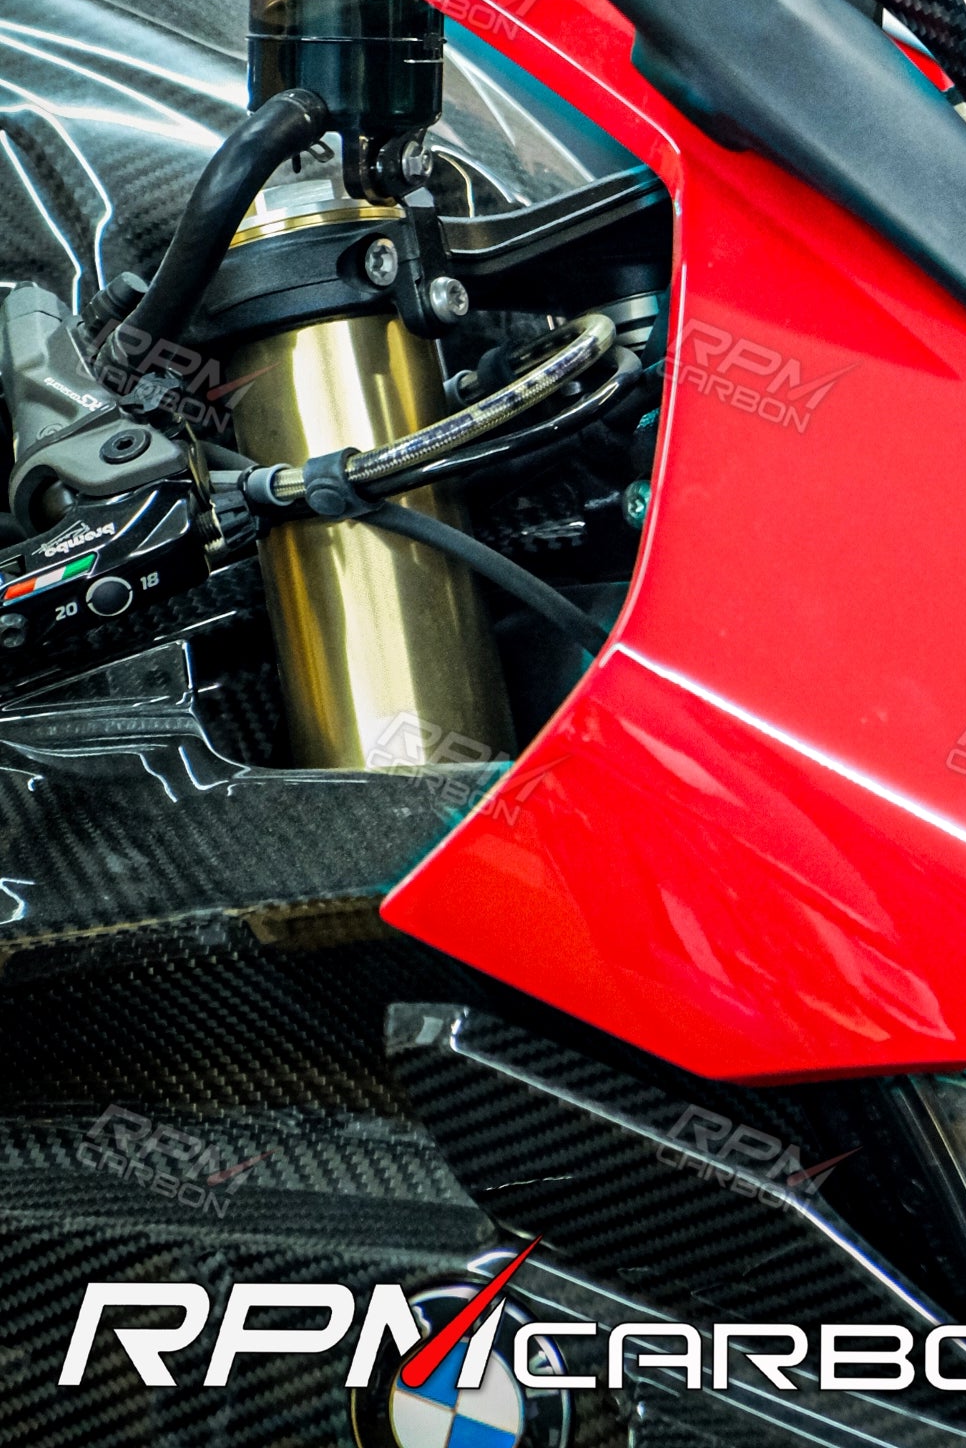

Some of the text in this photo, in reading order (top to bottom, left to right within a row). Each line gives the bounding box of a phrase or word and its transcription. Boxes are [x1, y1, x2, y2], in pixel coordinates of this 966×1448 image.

[44, 521, 116, 558] brembo
[139, 572, 160, 591] 18
[54, 602, 79, 621] 20
